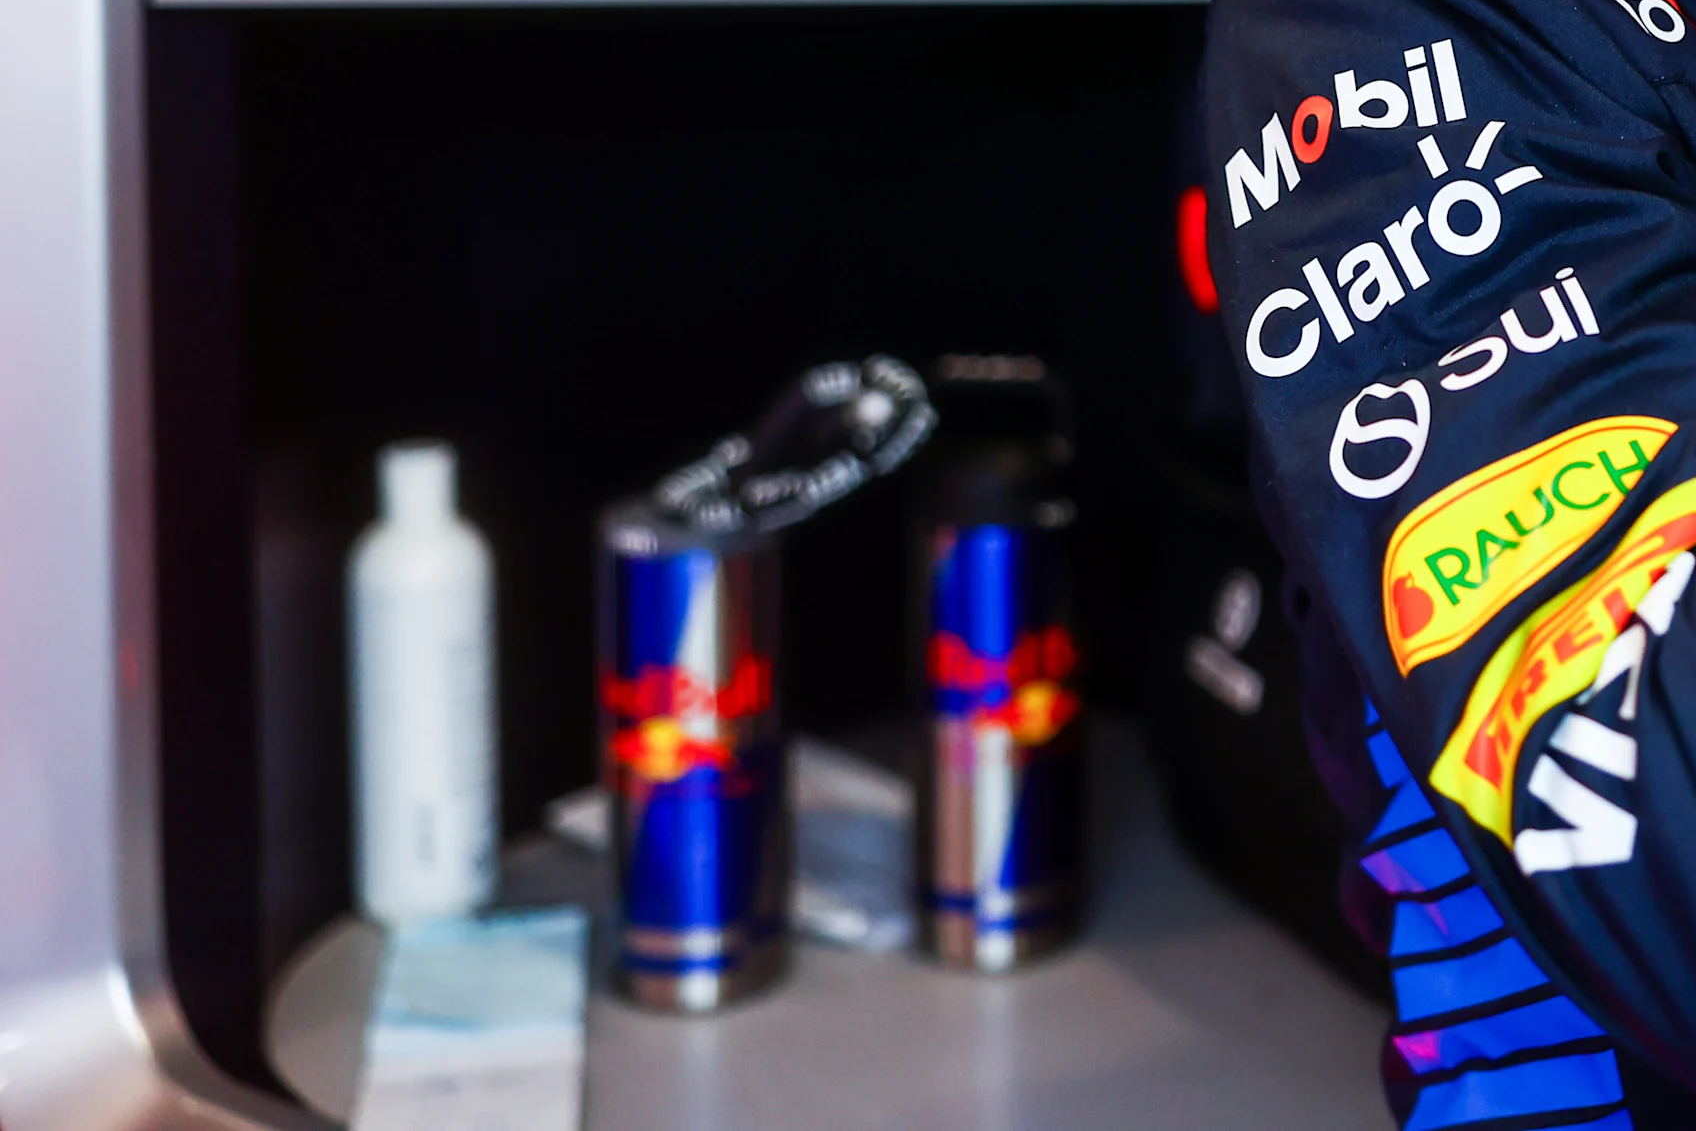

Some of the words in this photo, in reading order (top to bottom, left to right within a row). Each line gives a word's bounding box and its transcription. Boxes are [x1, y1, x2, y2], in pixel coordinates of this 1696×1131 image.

[1224, 38, 1467, 229] Mobil
[1246, 179, 1502, 378] Claro
[1437, 266, 1600, 391] sui
[1424, 439, 1653, 607] RAUCH
